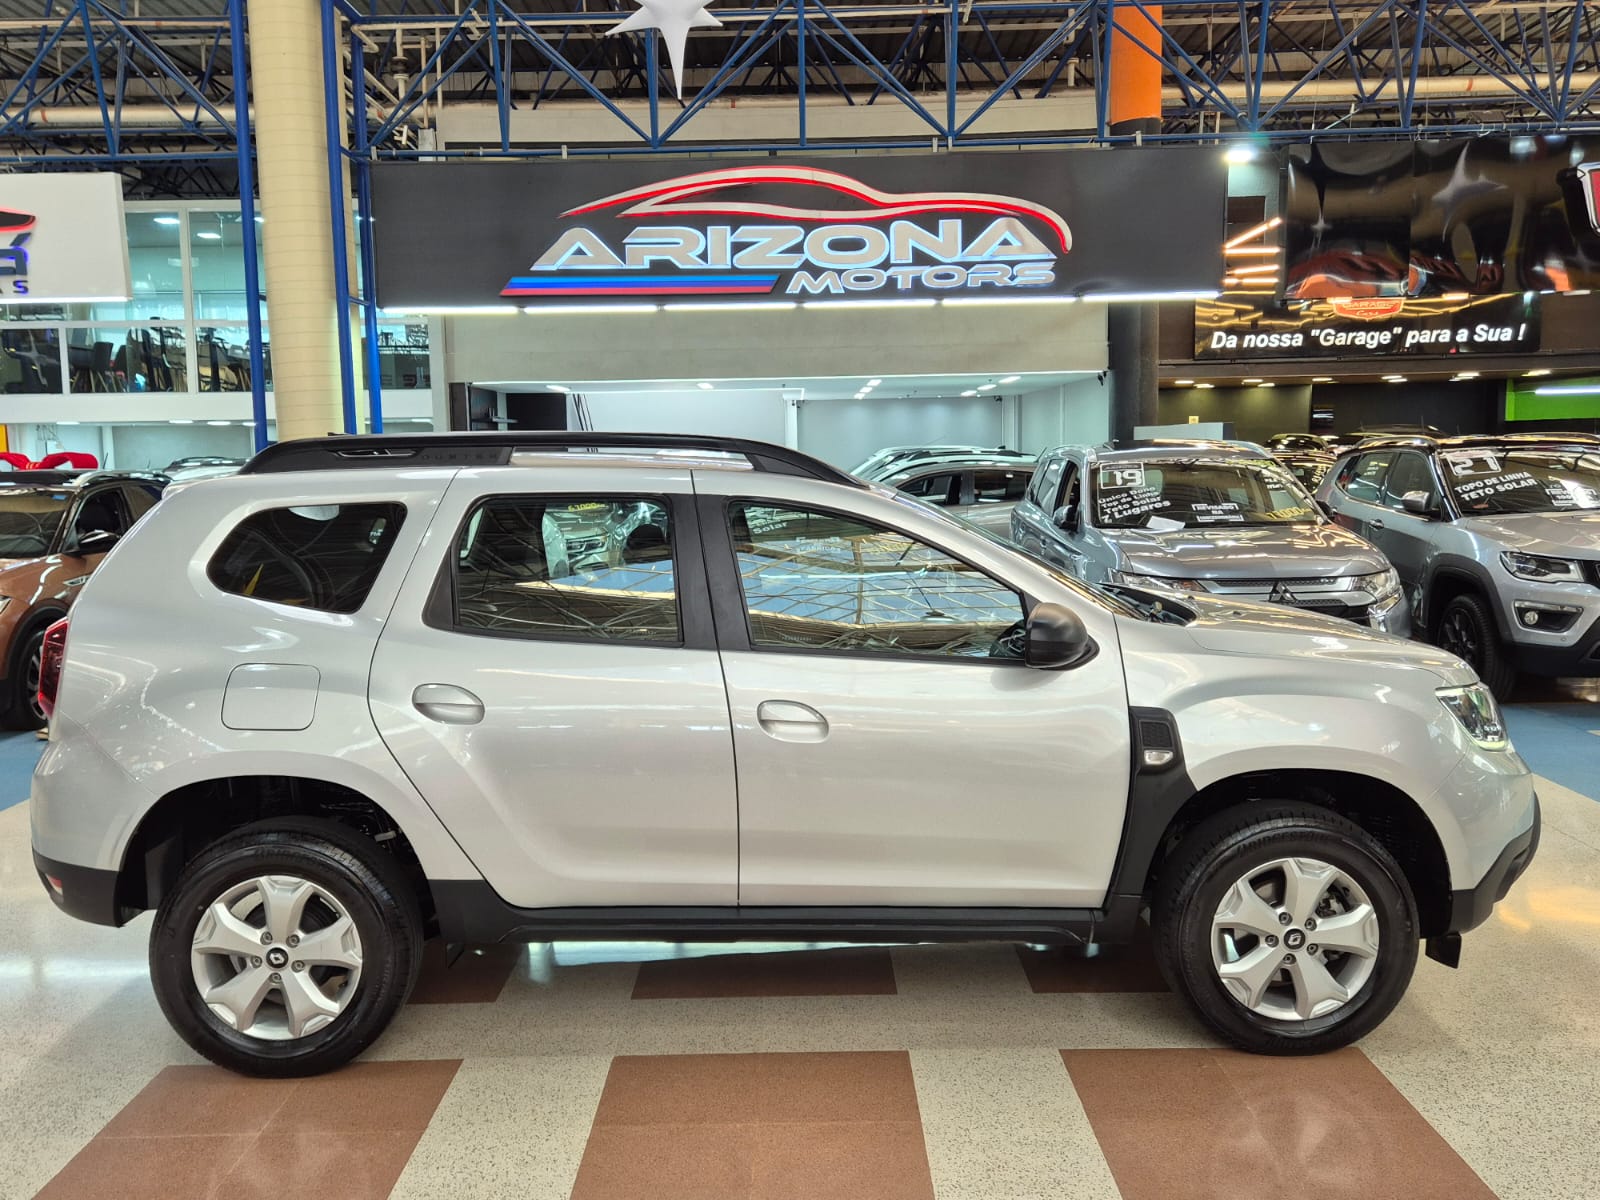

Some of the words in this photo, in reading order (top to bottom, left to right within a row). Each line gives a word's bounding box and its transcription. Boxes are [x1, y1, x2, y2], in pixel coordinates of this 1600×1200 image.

[530, 216, 1057, 270] ARIZONA
[785, 261, 1057, 293] MOTORS
[1211, 331, 1238, 349] Da
[1243, 333, 1304, 348] nossa
[1405, 328, 1451, 347] para
[1455, 328, 1469, 342] a
[1473, 324, 1513, 342] Sua
[1113, 470, 1142, 486] 19
[1454, 480, 1484, 493] TOPO
[1483, 477, 1500, 486] DE
[1498, 471, 1532, 482] LINHA
[1461, 488, 1495, 501] TETO
[1495, 478, 1538, 492] SOLAR
[1114, 500, 1171, 519] Lugares
